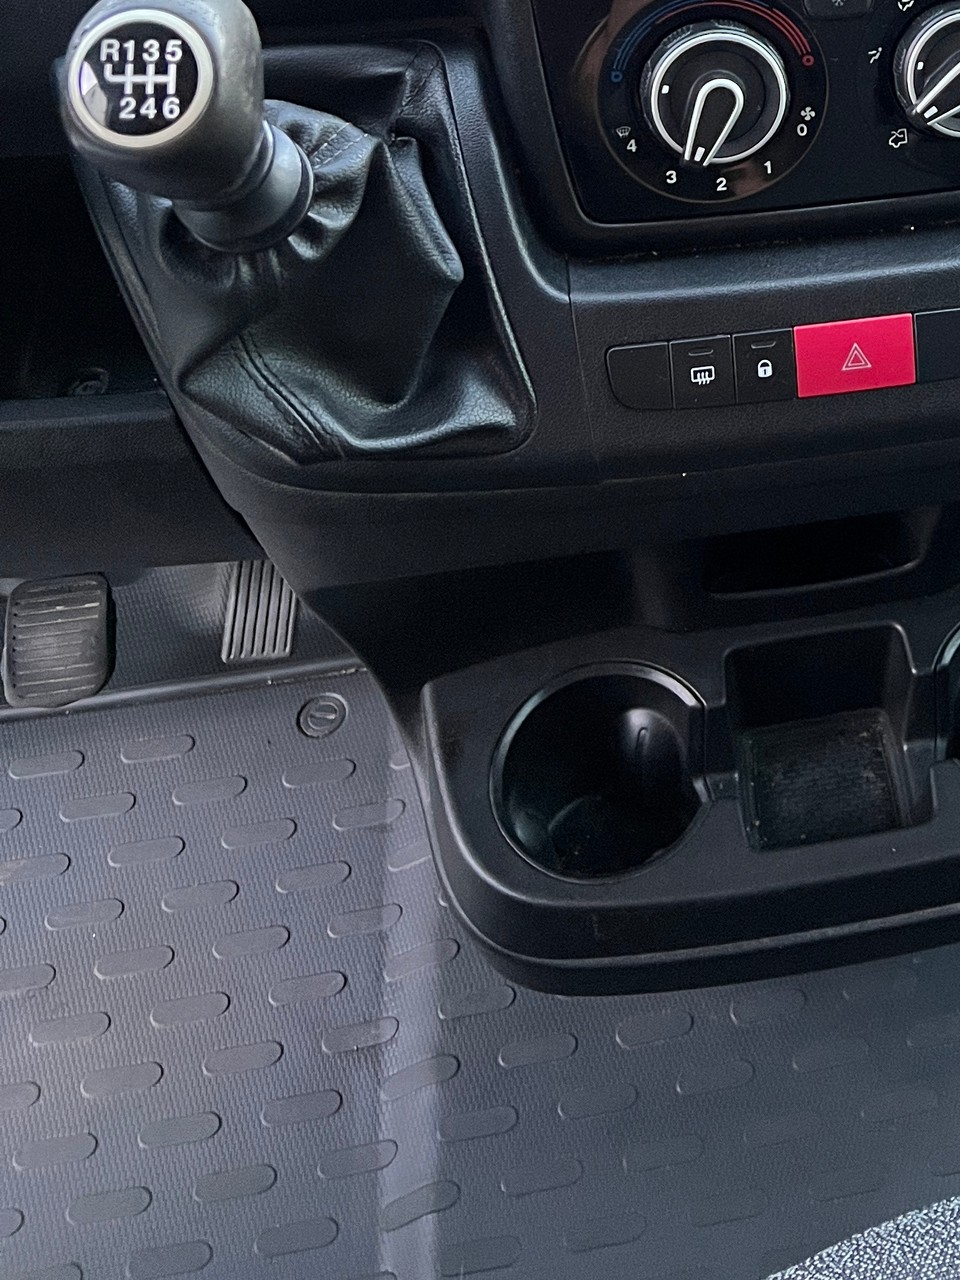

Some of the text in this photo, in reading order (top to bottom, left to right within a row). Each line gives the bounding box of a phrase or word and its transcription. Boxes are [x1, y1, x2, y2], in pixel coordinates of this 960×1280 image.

[796, 122, 808, 137] 0
[626, 138, 638, 153] 4
[763, 160, 773, 174] 1
[665, 170, 677, 184] 3
[715, 177, 728, 191] 2
